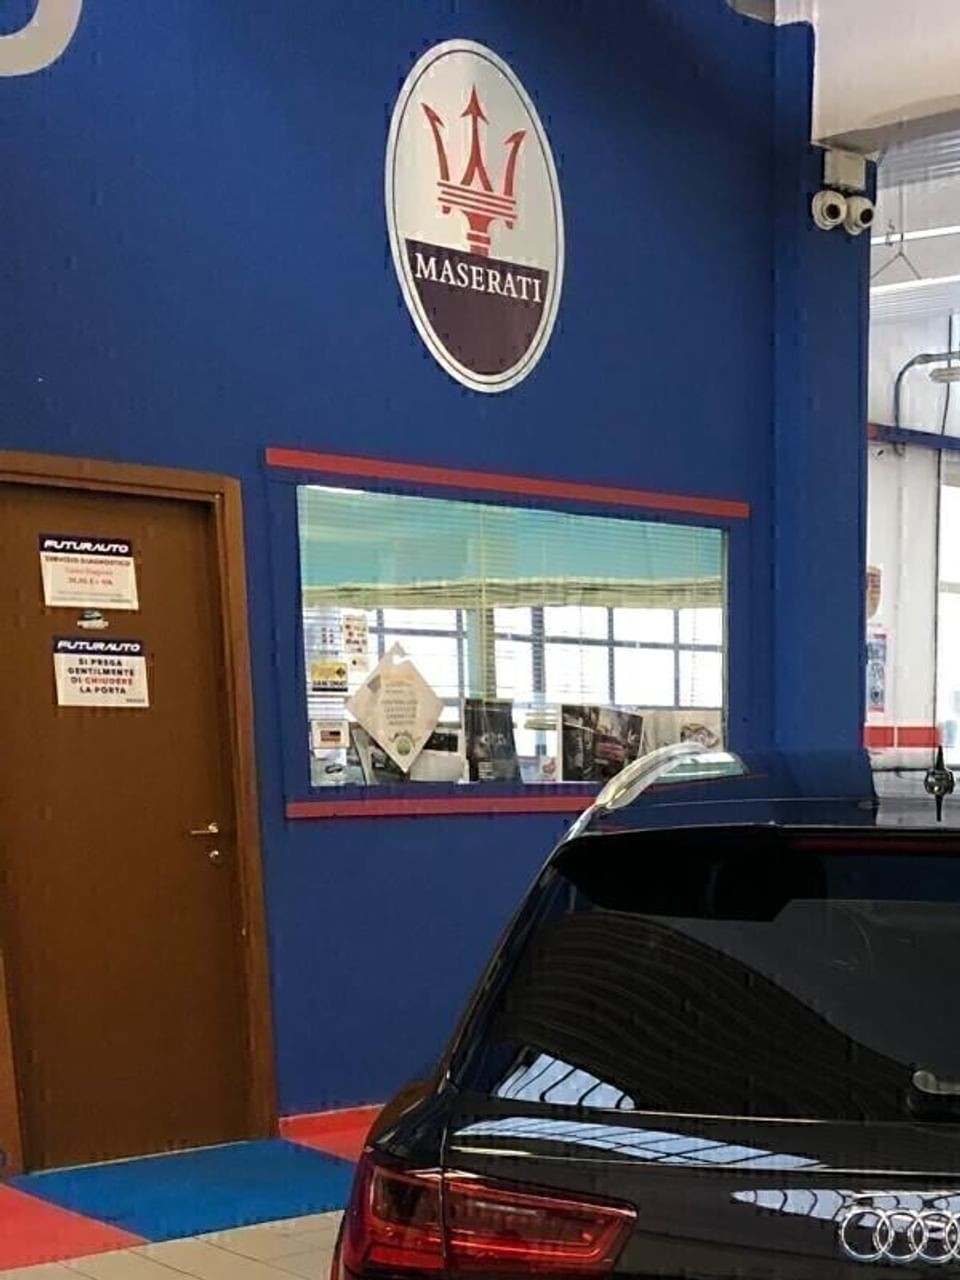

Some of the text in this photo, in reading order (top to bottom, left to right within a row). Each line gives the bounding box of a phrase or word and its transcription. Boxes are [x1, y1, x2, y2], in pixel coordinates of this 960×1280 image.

[414, 252, 542, 303] MASERATI
[43, 539, 129, 554] FUTURAUTO
[57, 640, 141, 652] FUTURAUTO
[67, 667, 135, 677] GENTILMENTE
[85, 677, 133, 686] CHIUDERE
[94, 687, 127, 695] PORTA
